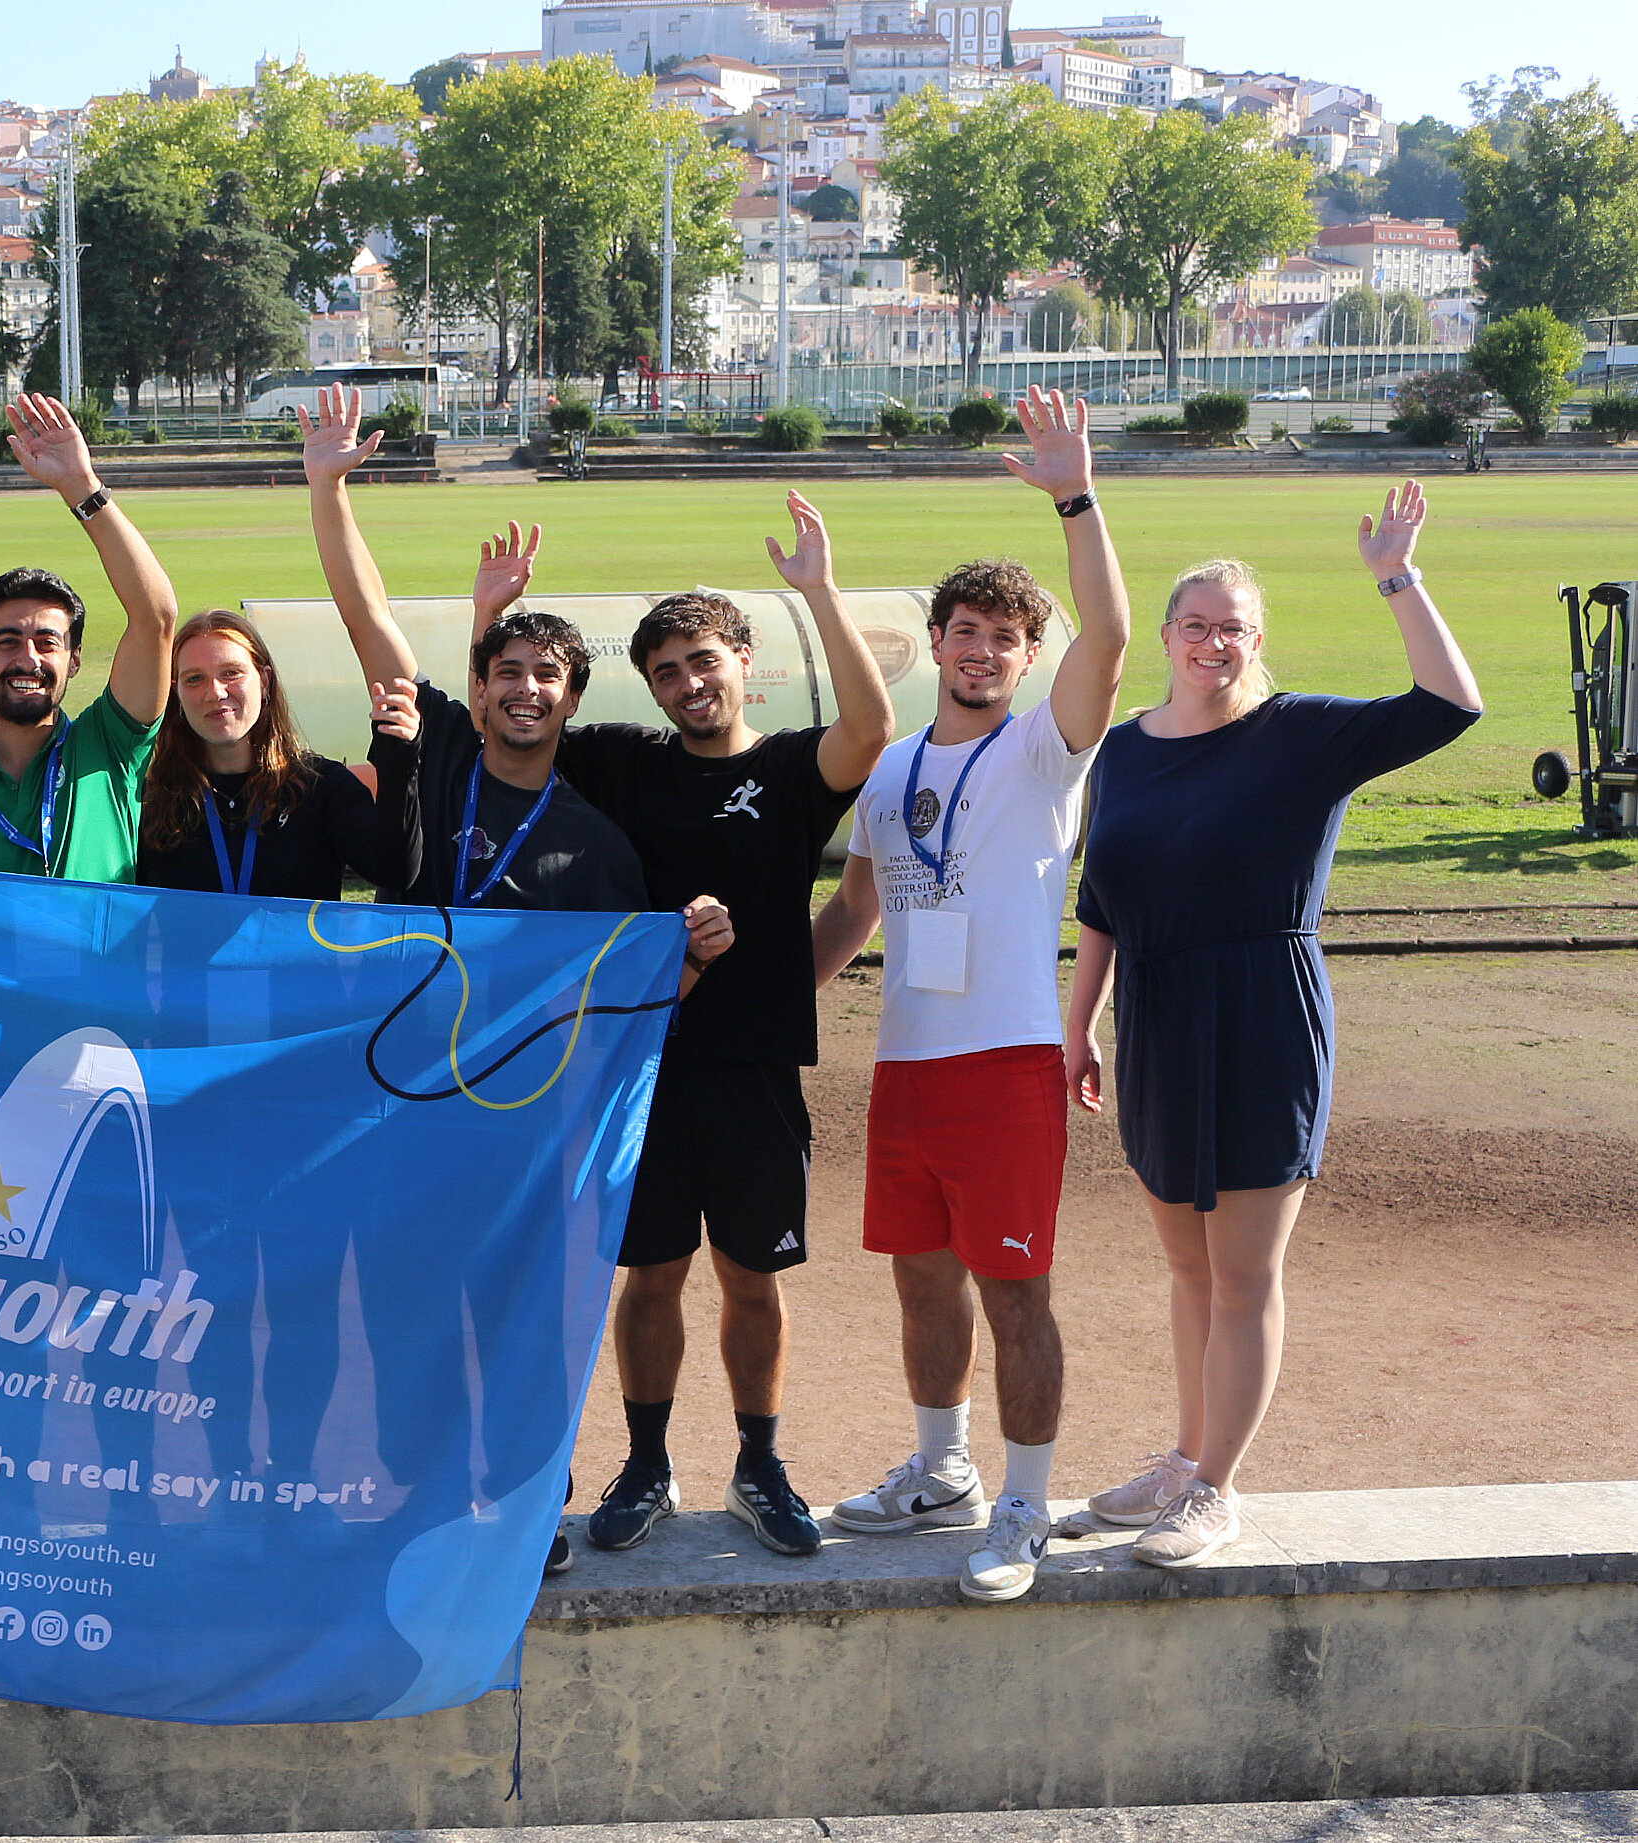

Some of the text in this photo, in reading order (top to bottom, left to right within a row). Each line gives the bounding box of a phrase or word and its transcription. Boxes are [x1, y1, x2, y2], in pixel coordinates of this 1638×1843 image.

[63, 1375, 97, 1405] in
[103, 1385, 217, 1424] europe
[26, 1459, 51, 1483] a
[61, 1459, 140, 1493] real
[151, 1470, 220, 1508] say
[230, 1470, 264, 1502] in
